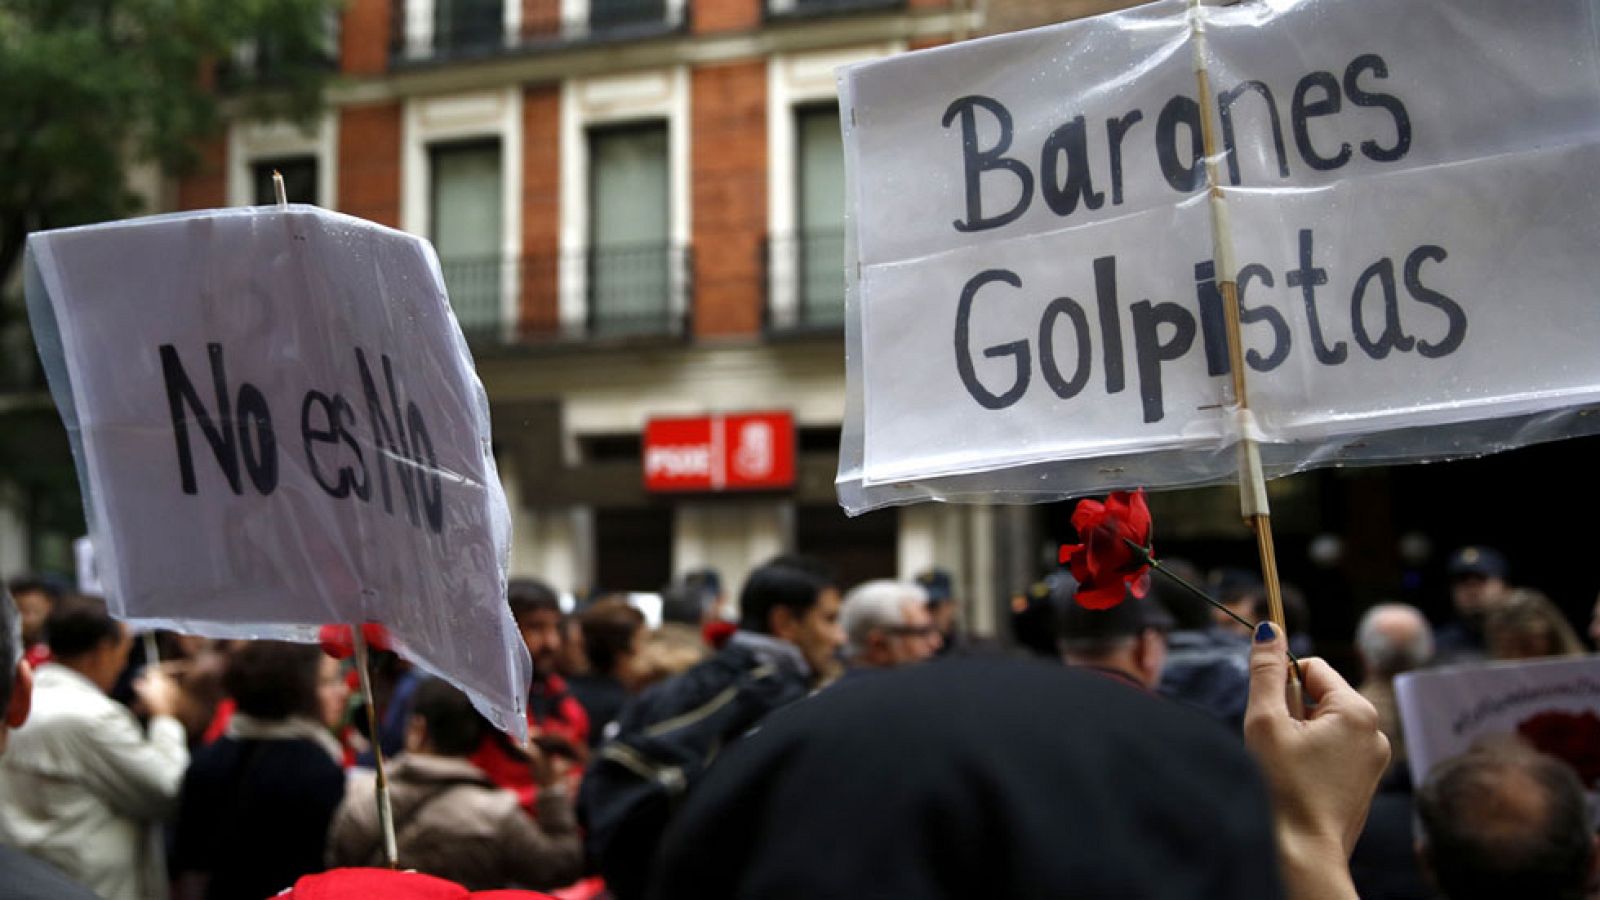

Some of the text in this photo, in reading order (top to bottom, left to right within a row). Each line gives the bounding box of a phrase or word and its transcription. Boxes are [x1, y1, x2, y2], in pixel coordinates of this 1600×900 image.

[942, 53, 1412, 233] Barones
[954, 229, 1467, 422] Golpistas
[159, 342, 443, 534] No es No
